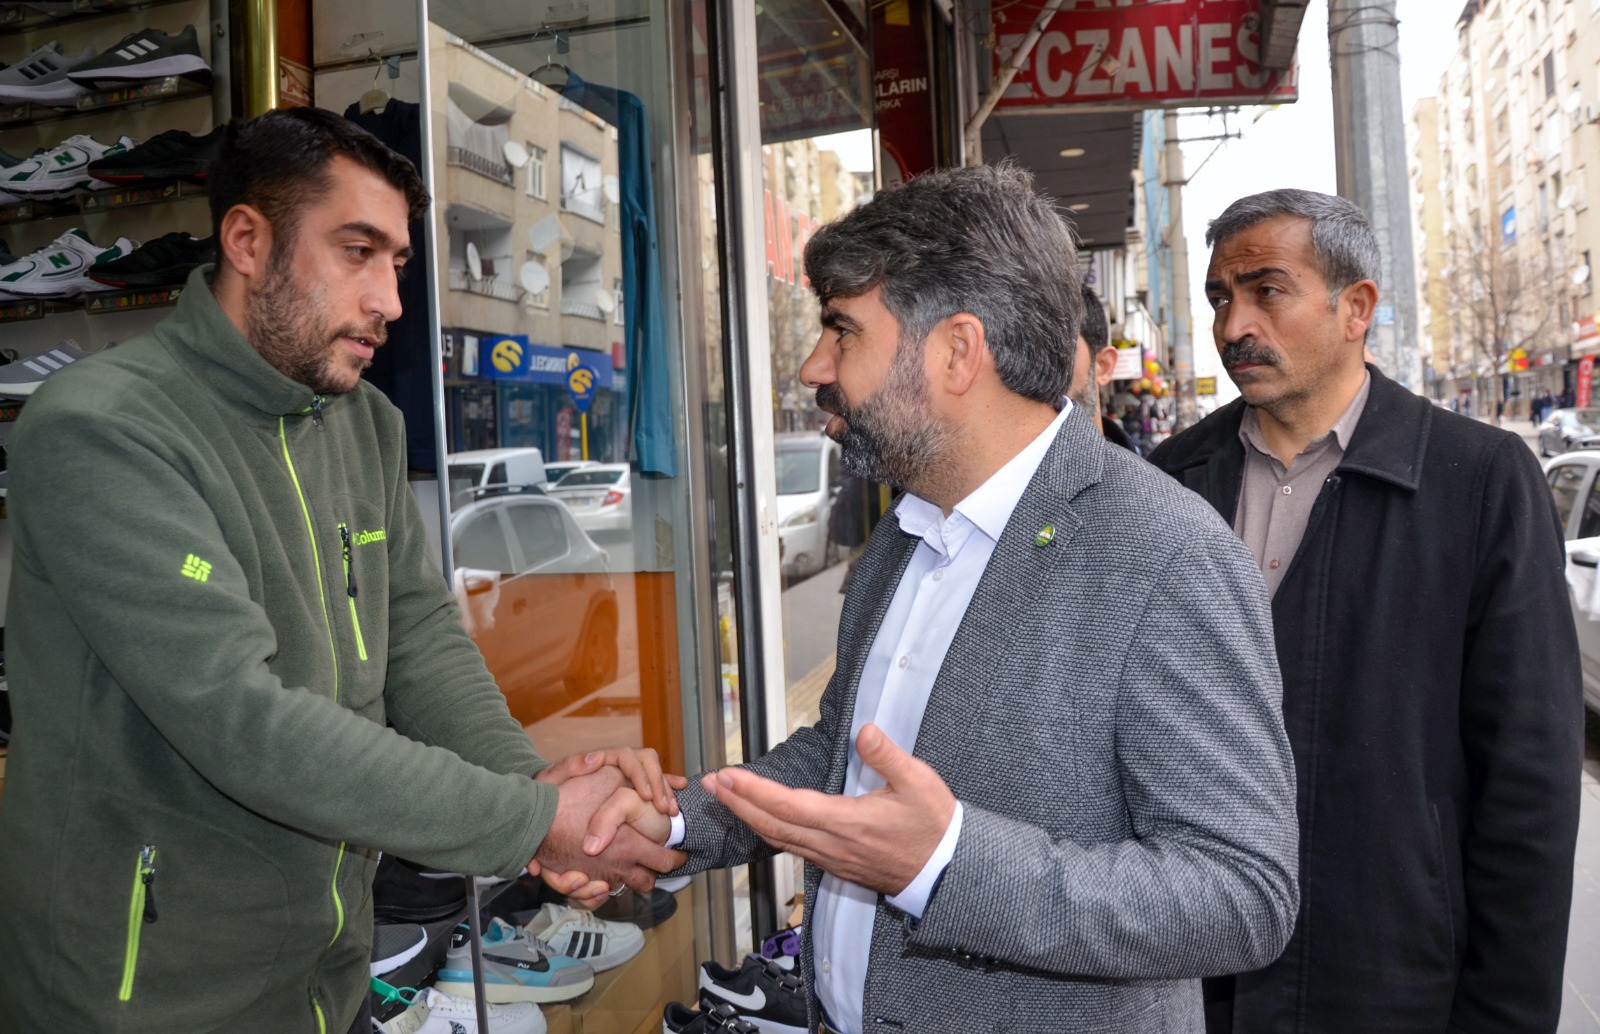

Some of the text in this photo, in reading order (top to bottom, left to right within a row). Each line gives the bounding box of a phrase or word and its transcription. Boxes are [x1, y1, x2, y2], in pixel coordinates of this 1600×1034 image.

[999, 12, 1291, 97] ECZANES
[874, 68, 900, 80] ARŞI
[352, 526, 386, 546] Colum
